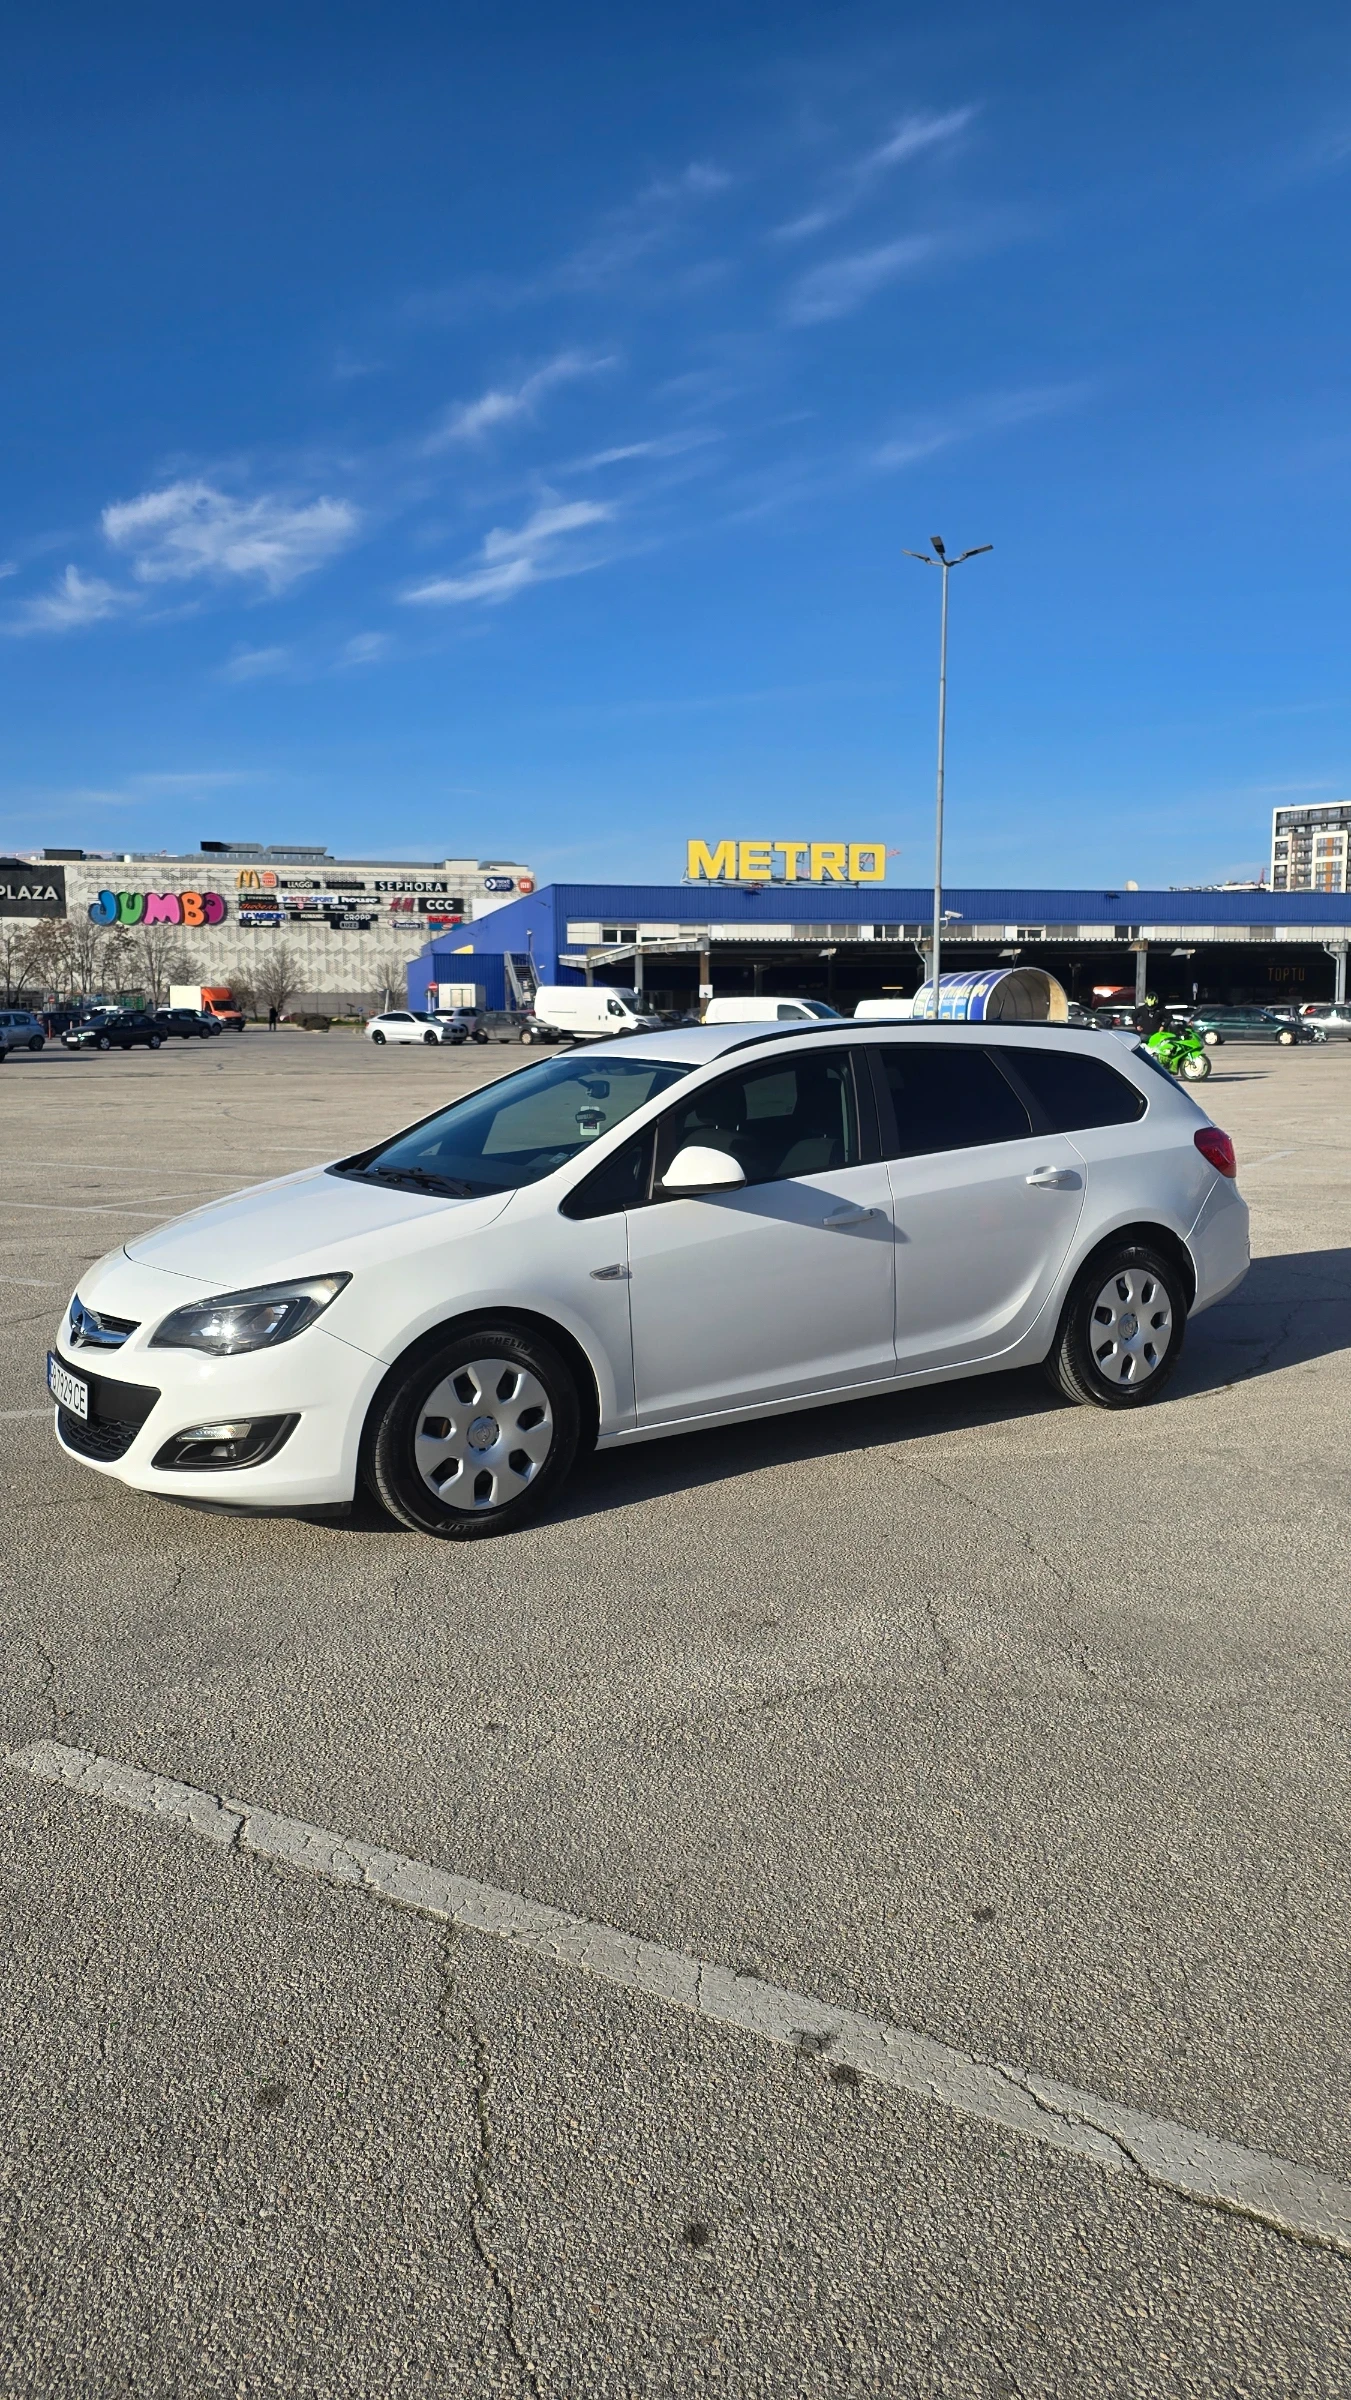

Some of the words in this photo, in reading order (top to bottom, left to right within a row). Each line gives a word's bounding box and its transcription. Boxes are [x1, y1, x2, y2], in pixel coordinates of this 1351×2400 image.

[687, 839, 885, 881] METRO
[0, 884, 58, 900] PLAZA
[378, 881, 442, 892] SEPHORA
[88, 889, 226, 927] JUMBO
[426, 900, 453, 911] CCC
[468, 1335, 530, 1353] MICHELIN
